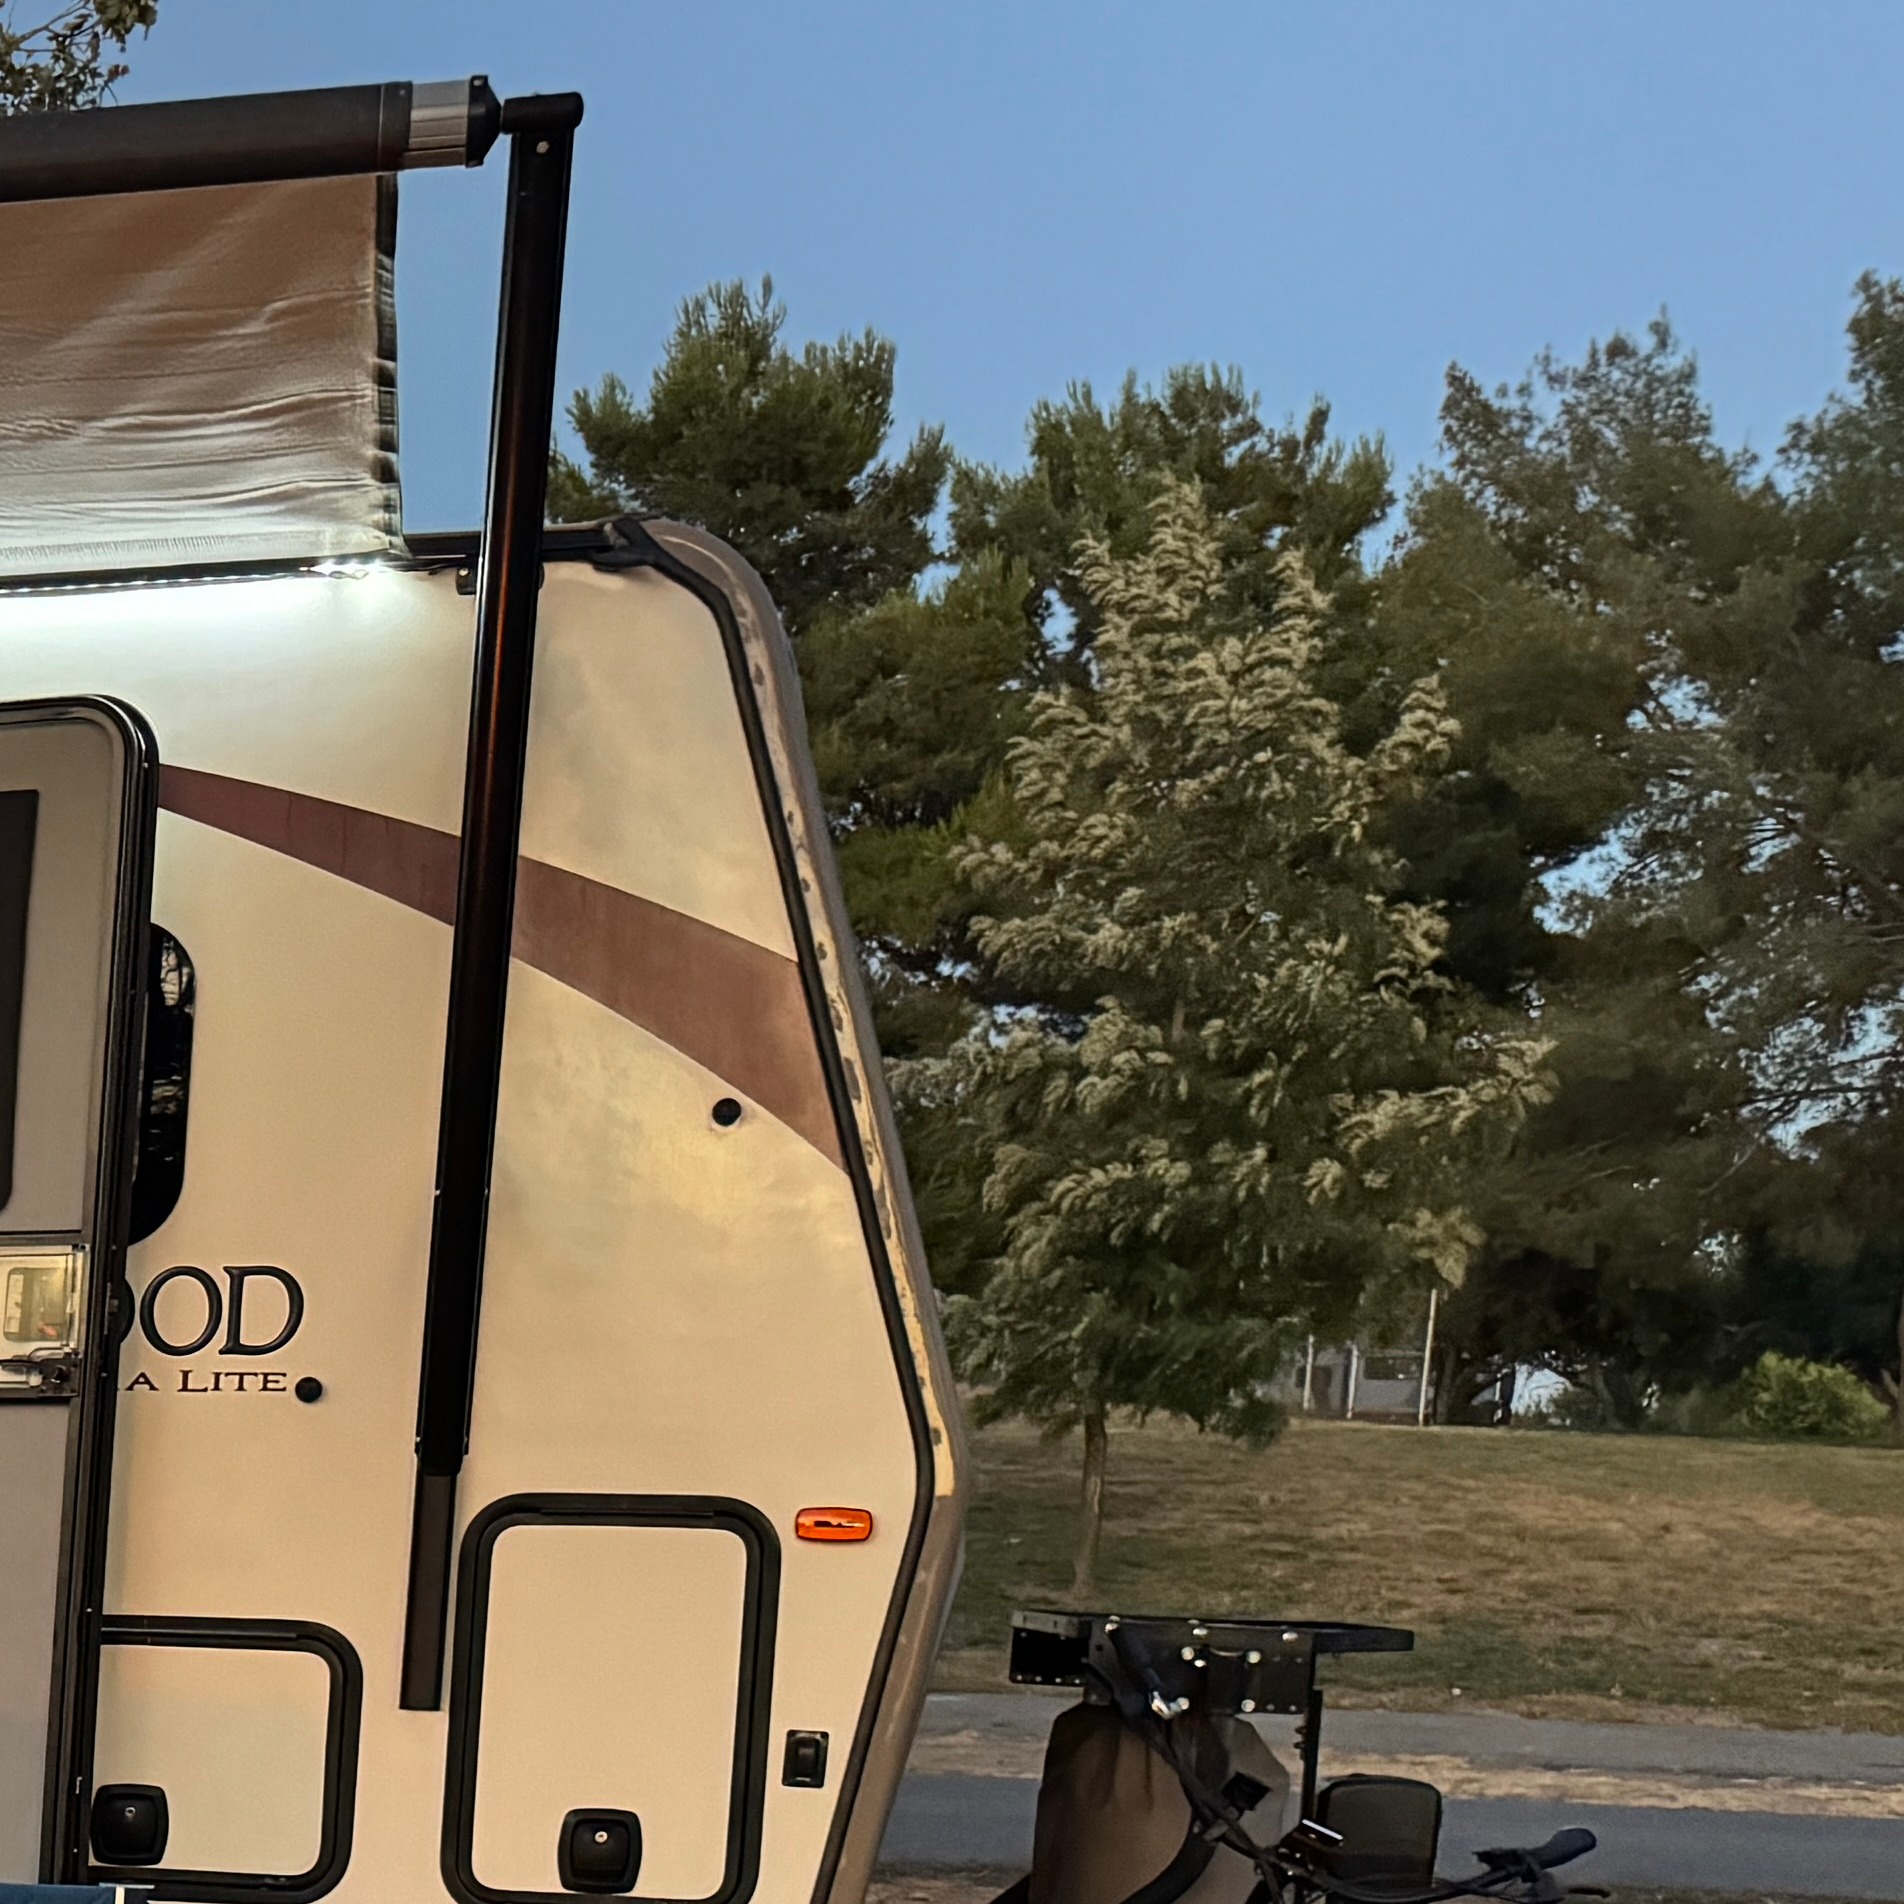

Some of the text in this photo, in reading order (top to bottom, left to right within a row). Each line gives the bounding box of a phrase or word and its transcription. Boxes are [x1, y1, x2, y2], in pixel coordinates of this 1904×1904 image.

[119, 1265, 304, 1357] OD
[117, 1369, 287, 1392] A LITE
